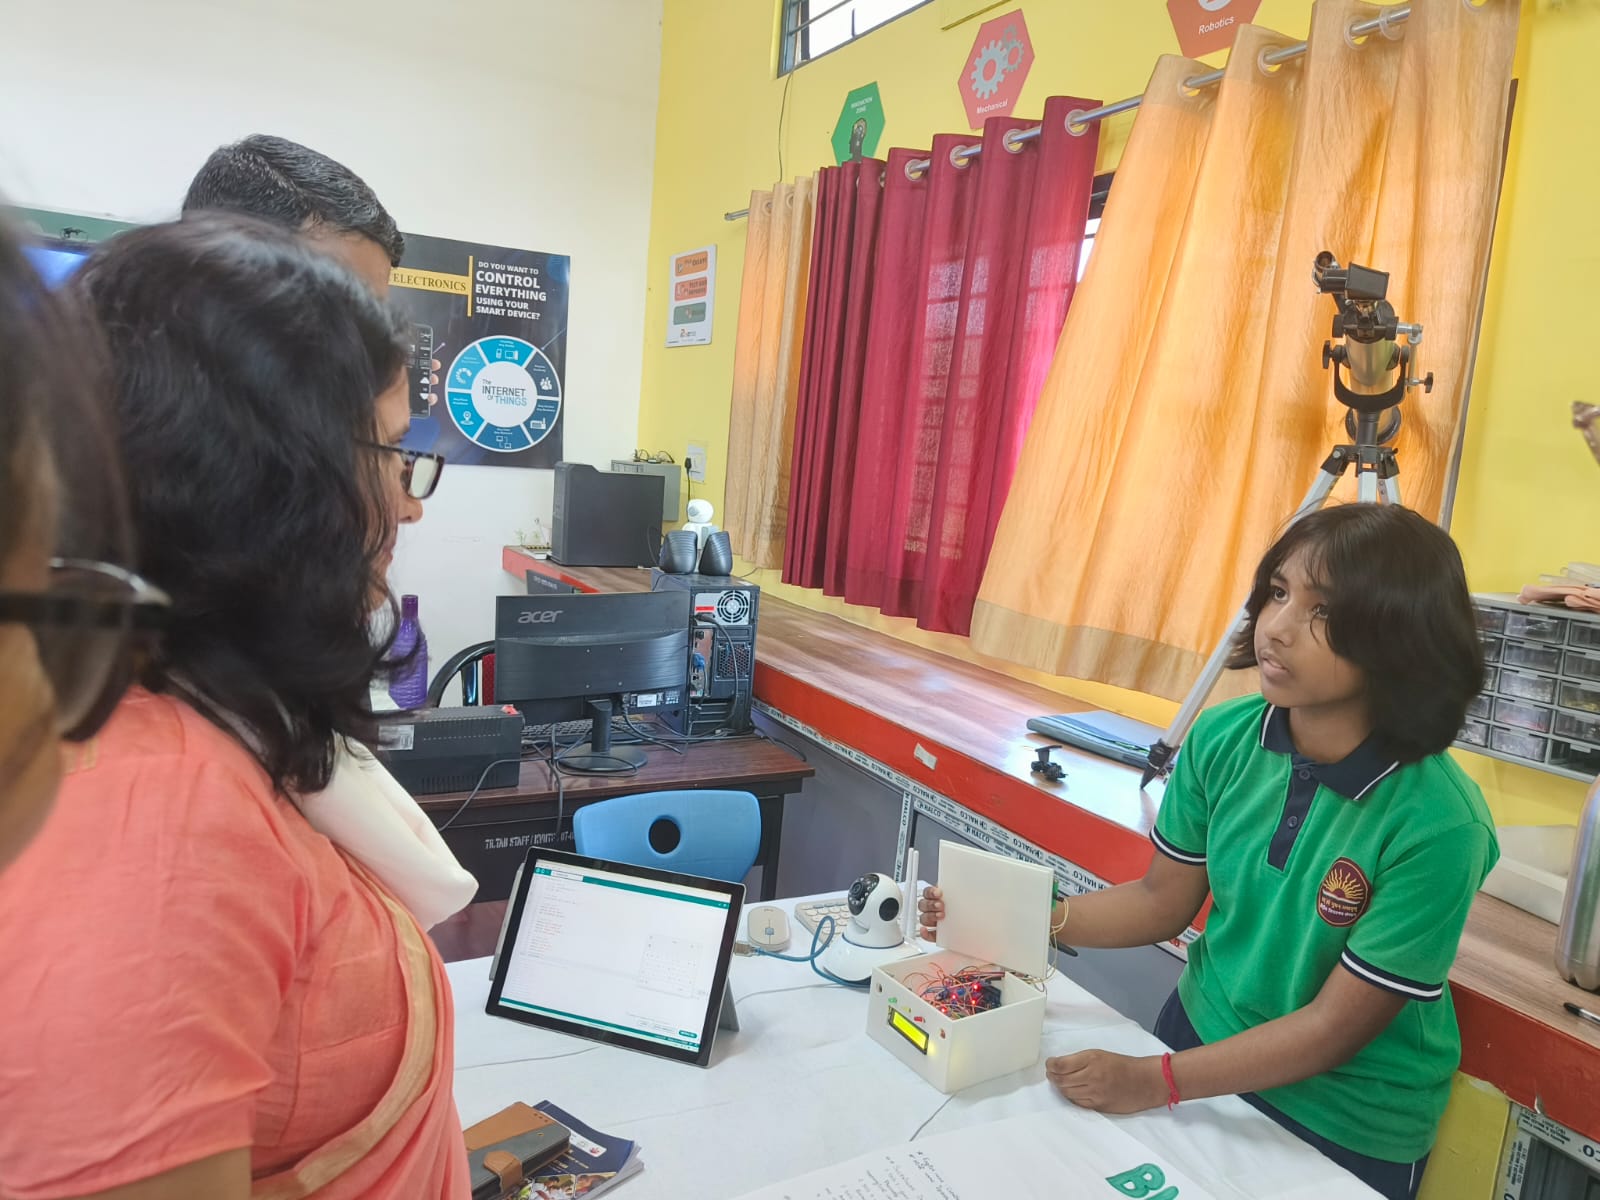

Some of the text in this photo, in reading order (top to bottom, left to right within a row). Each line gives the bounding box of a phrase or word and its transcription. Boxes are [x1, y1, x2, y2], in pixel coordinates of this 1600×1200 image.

[1198, 16, 1235, 35] Robotics
[976, 98, 1008, 114] Mechanical
[478, 261, 489, 269] DO
[490, 262, 506, 271] YOU
[507, 265, 529, 274] WANT
[393, 273, 467, 291] ELECTRONICS
[476, 270, 541, 289] CONTROL
[475, 284, 547, 302] EVERYTHING
[476, 297, 529, 310] USING YOUR
[475, 306, 541, 320] SMART DEVICE?
[482, 385, 527, 397] INTERNET
[494, 395, 528, 407] THINGS
[518, 610, 564, 623] acer
